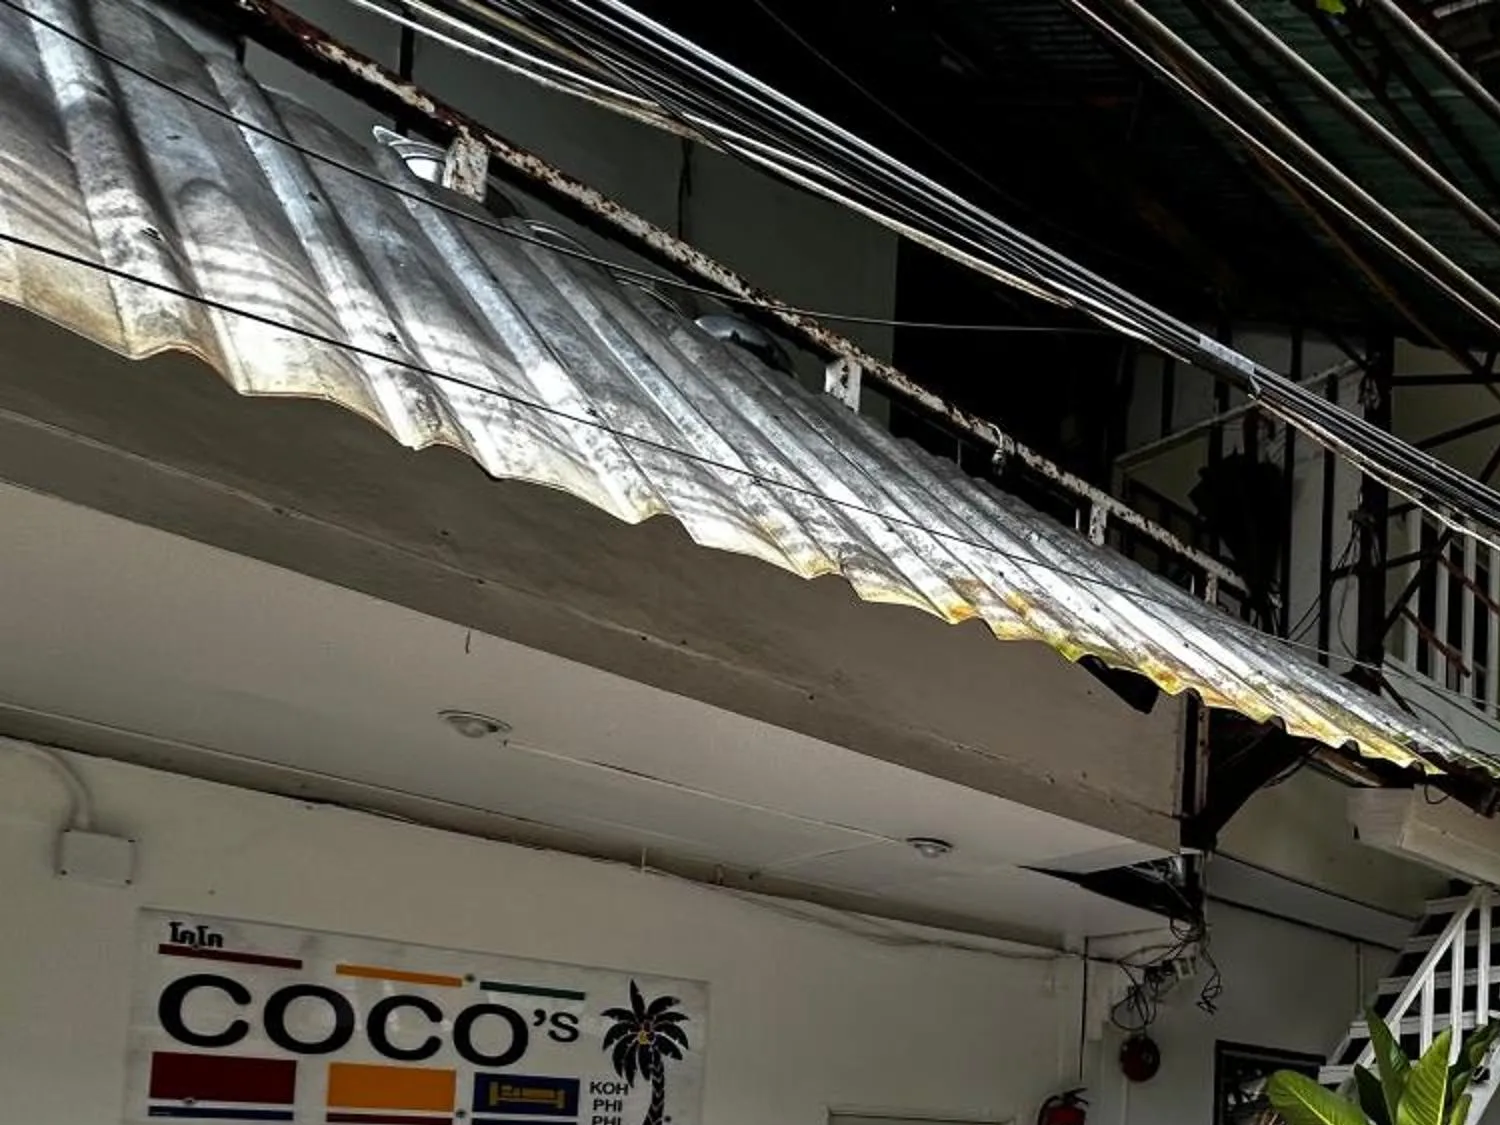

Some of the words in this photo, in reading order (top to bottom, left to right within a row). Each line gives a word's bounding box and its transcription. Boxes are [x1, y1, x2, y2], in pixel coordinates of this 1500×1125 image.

[157, 973, 580, 1068] COCO'S
[589, 1081, 629, 1096] KOH
[592, 1098, 623, 1113] PHI
